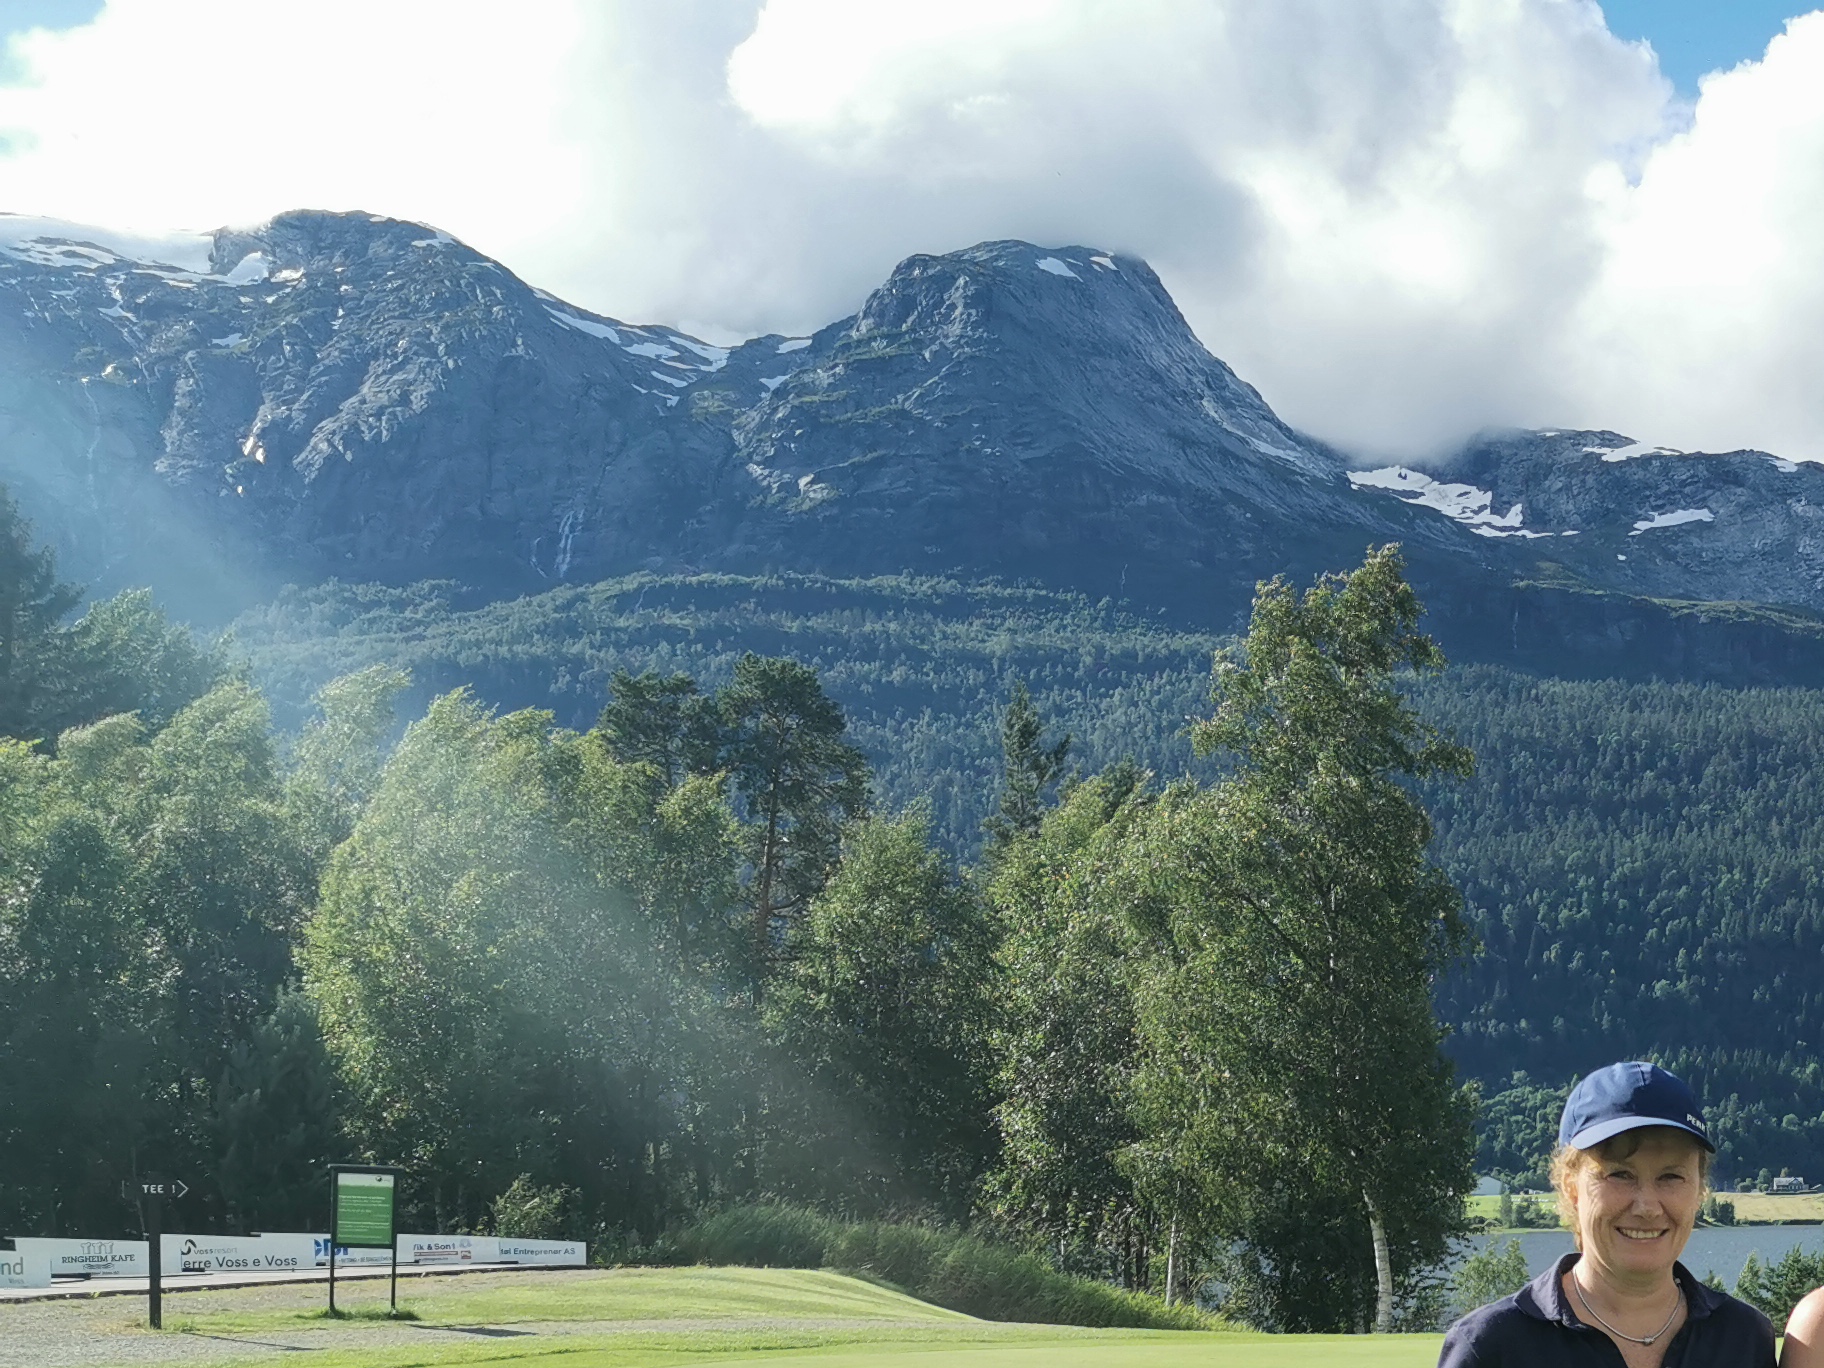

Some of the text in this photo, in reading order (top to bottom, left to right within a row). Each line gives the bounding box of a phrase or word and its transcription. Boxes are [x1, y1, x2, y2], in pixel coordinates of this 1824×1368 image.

[142, 1184, 164, 1194] TEE
[513, 1247, 562, 1256] Entreprenør
[563, 1247, 576, 1255] AS
[61, 1255, 109, 1264] RINGHEIM
[215, 1256, 249, 1268] Voss
[252, 1258, 261, 1267] e
[265, 1255, 298, 1266] Voss
